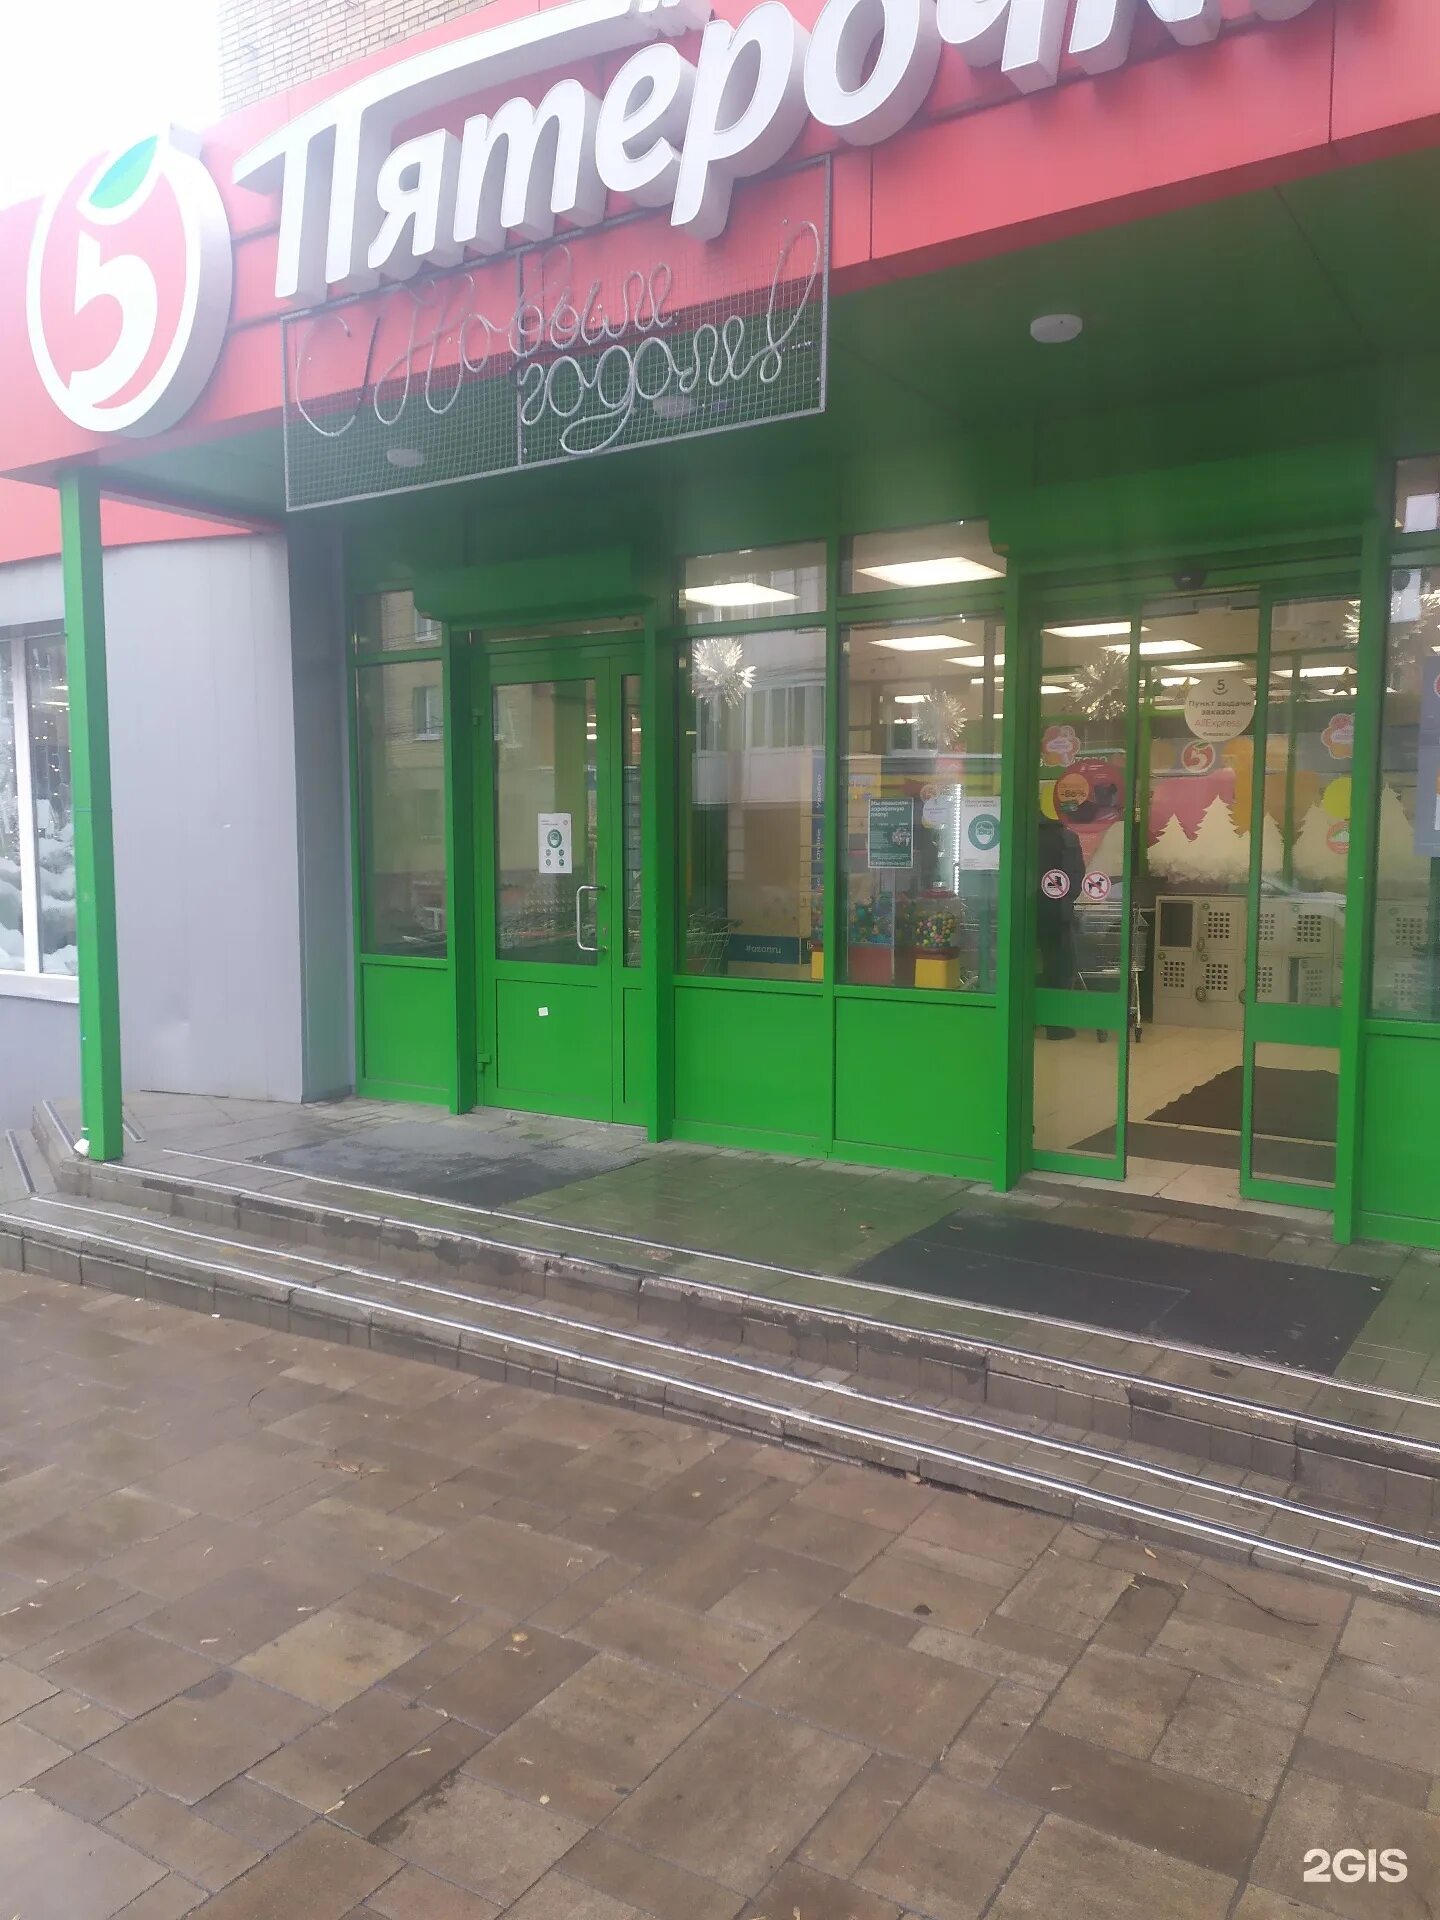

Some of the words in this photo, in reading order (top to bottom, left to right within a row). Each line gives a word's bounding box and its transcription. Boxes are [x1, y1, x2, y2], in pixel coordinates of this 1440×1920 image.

[1188, 700, 1215, 708] Пункт
[1217, 700, 1252, 708] выдачи
[1194, 718, 1242, 728] AliExpress
[745, 944, 782, 954] #ozonru
